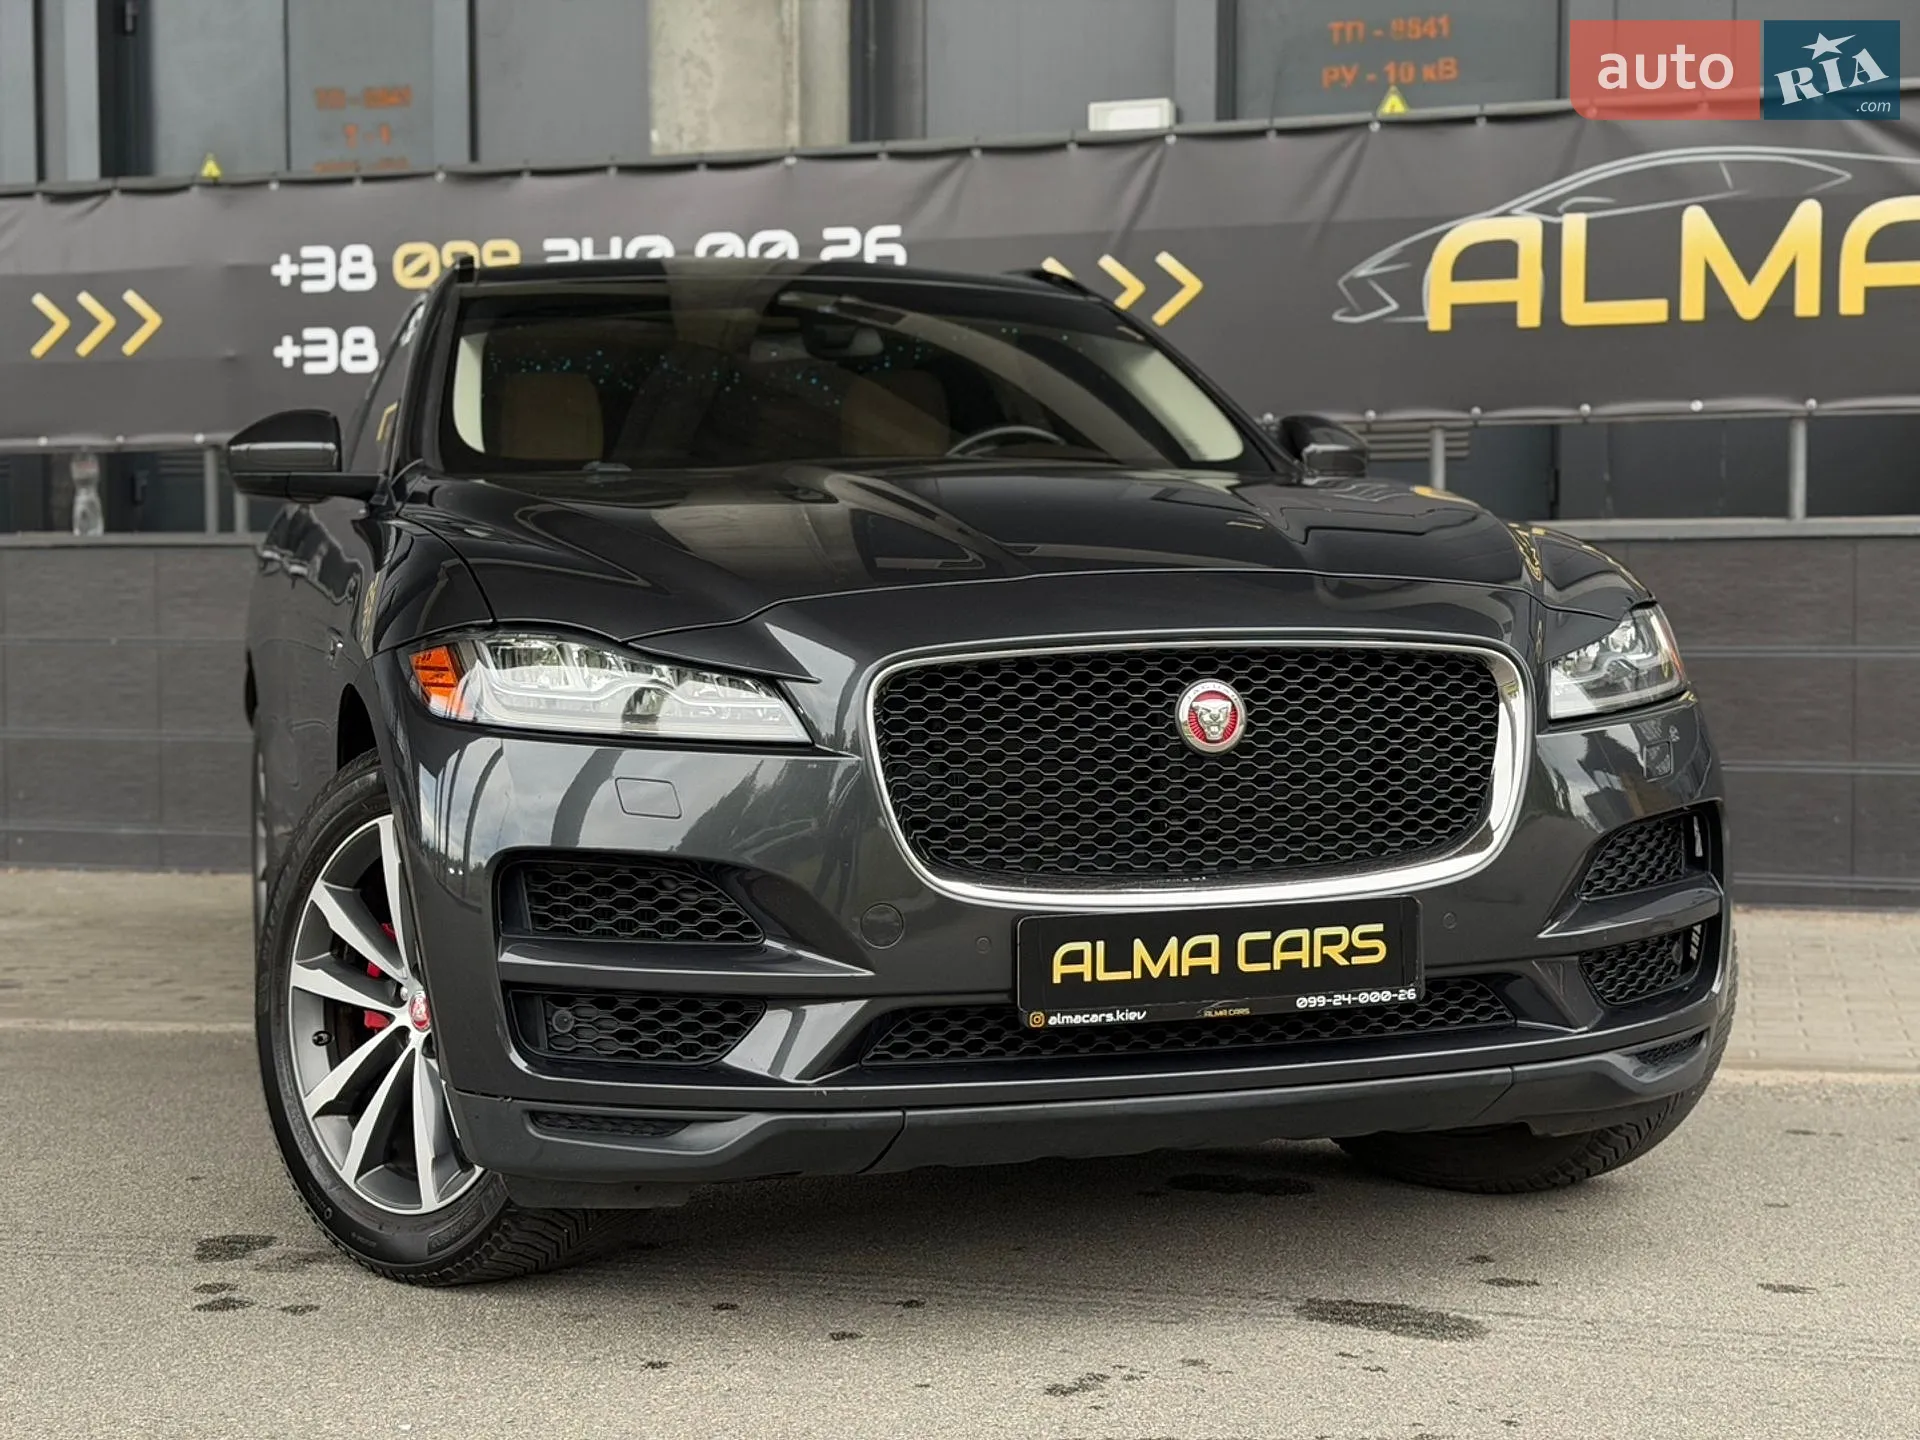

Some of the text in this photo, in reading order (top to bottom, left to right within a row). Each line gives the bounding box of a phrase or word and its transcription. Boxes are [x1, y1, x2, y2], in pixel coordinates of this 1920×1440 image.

[1384, 60, 1416, 84] 10
[271, 244, 377, 293] +38
[1427, 195, 1920, 331] ALMA
[273, 326, 379, 375] +38
[1052, 923, 1387, 984] ALMA CARS
[1048, 1010, 1147, 1026] almacars.kiev
[1296, 988, 1417, 1009] 099-24-000-26
